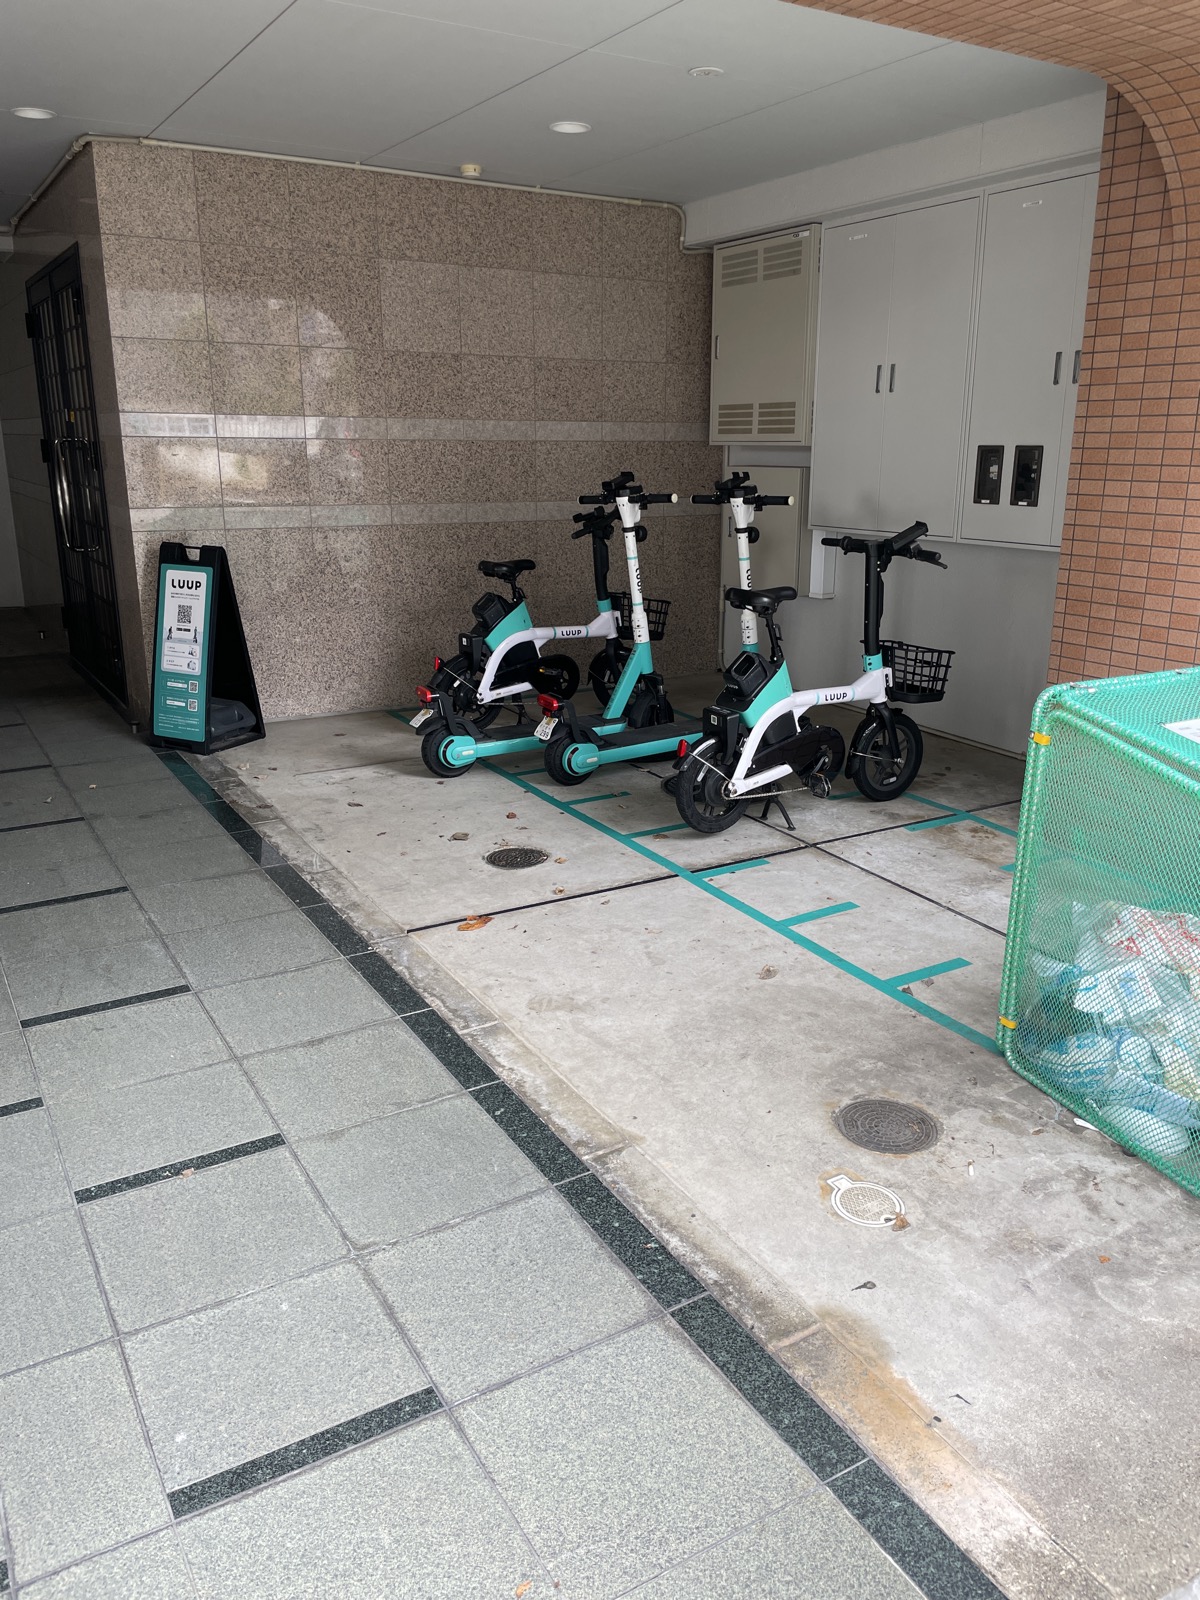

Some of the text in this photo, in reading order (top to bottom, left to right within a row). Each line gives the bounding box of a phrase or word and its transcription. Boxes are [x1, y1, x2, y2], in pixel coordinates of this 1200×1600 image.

[171, 578, 202, 591] LUUP
[561, 629, 582, 637] LUUP
[824, 692, 848, 702] LUUP
